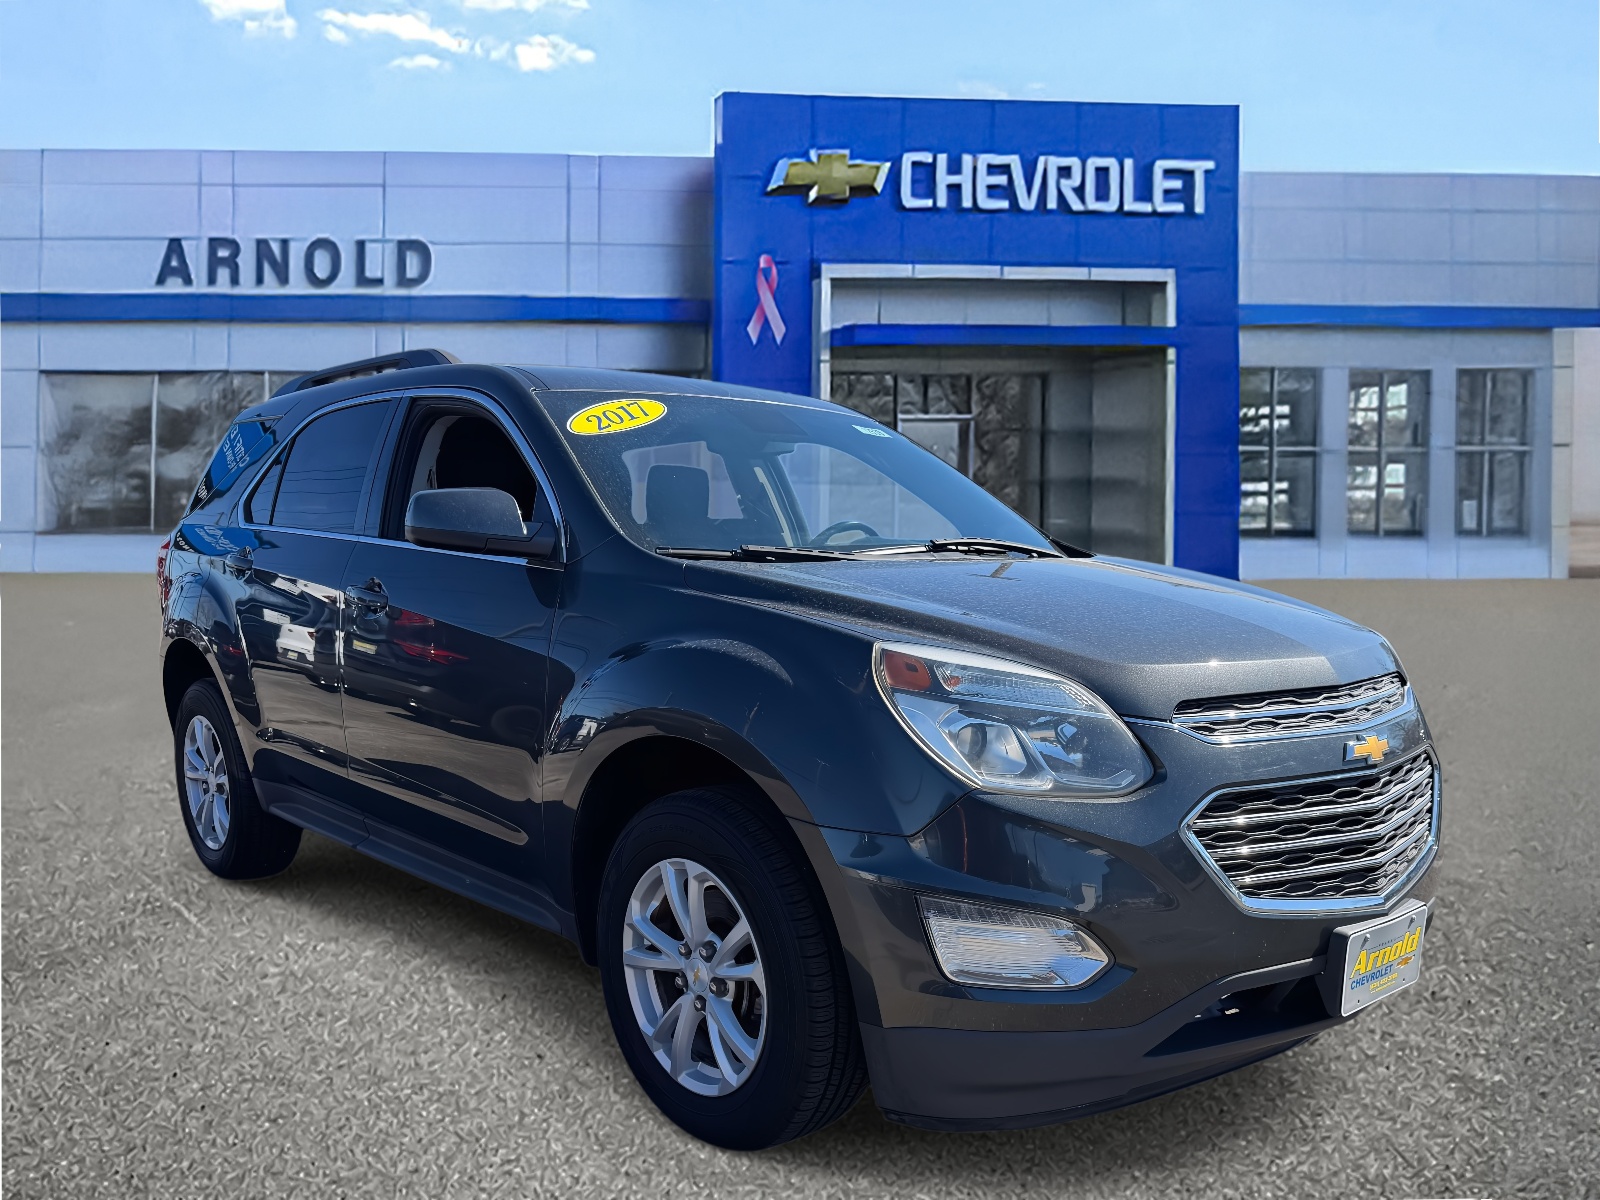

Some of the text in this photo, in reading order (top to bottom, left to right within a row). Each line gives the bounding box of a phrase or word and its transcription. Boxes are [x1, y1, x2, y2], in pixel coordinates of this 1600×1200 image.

[901, 151, 1215, 214] CHEVROLET
[155, 237, 433, 289] ARNOLD
[585, 402, 649, 431] 2017
[1349, 926, 1421, 979] Arnold
[1350, 964, 1393, 990] CHEVROLET
